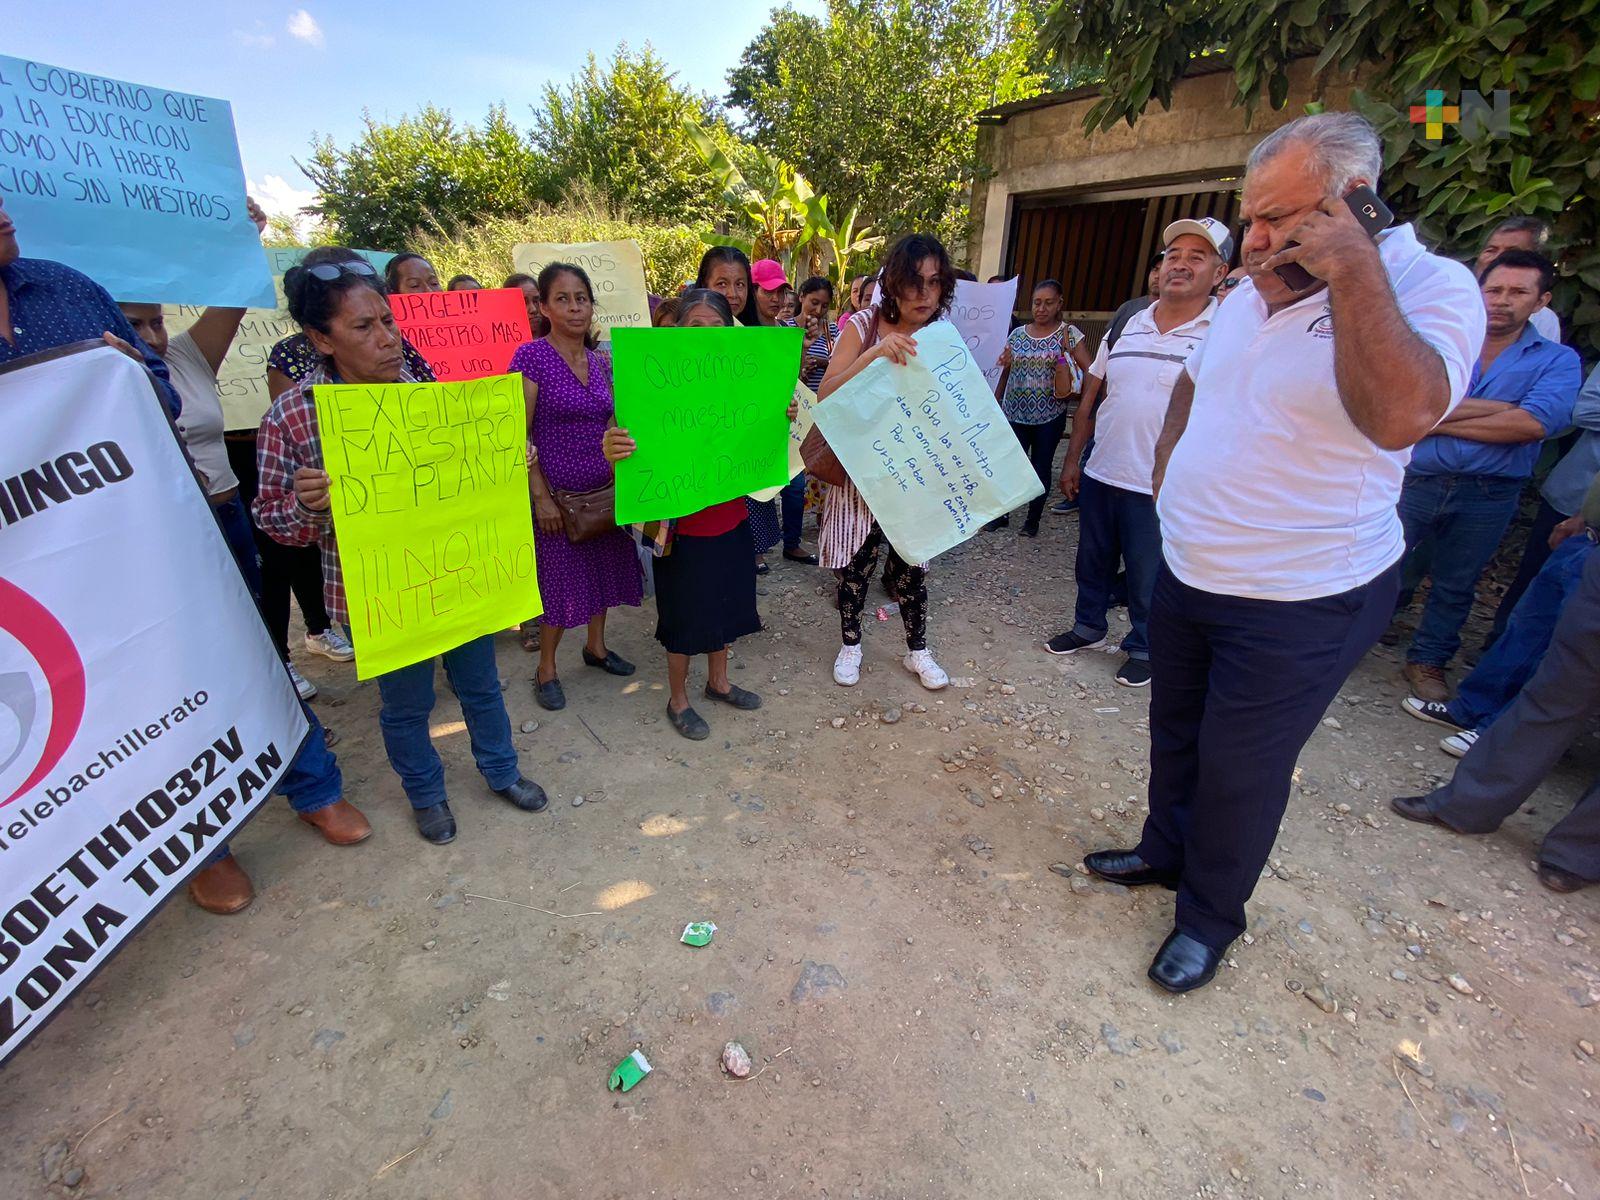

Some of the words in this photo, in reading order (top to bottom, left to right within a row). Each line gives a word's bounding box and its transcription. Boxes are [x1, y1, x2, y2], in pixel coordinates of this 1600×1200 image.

[25, 61, 153, 112] GOBIERNO
[164, 93, 208, 123] QUE
[15, 95, 49, 128] LA
[62, 104, 191, 152] EDUCACION
[0, 128, 56, 161] OMO
[60, 137, 102, 168] VA
[110, 145, 184, 184] HABER
[0, 163, 57, 198] CION
[63, 171, 111, 204] SIN
[120, 178, 231, 222] MAESTROS
[401, 324, 484, 348] MAESTRO
[491, 321, 523, 344] MAS
[341, 414, 515, 474] MAESTRO
[340, 472, 406, 516] DE
[412, 445, 527, 507] PLANTA
[365, 542, 534, 638] INTERINO
[122, 742, 284, 897] TUXPAN
